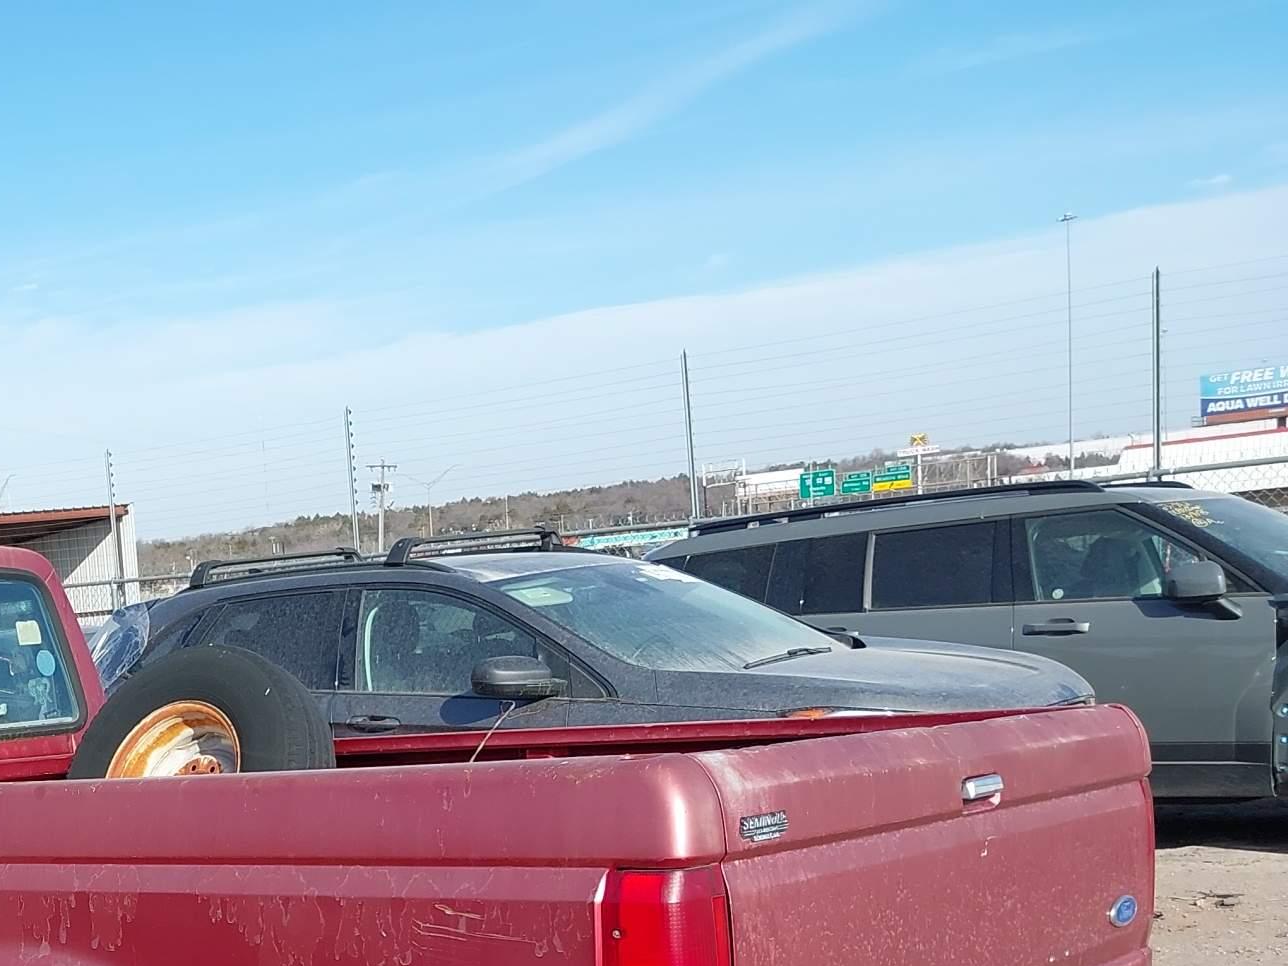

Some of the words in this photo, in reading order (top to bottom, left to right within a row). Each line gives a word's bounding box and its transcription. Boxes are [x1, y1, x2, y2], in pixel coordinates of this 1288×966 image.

[1209, 373, 1229, 383] GET
[1230, 367, 1275, 385] FREE
[1217, 386, 1238, 396] FOR
[1239, 382, 1271, 393] LAWN
[1207, 399, 1244, 413] AQUA
[1246, 394, 1282, 408] WELL
